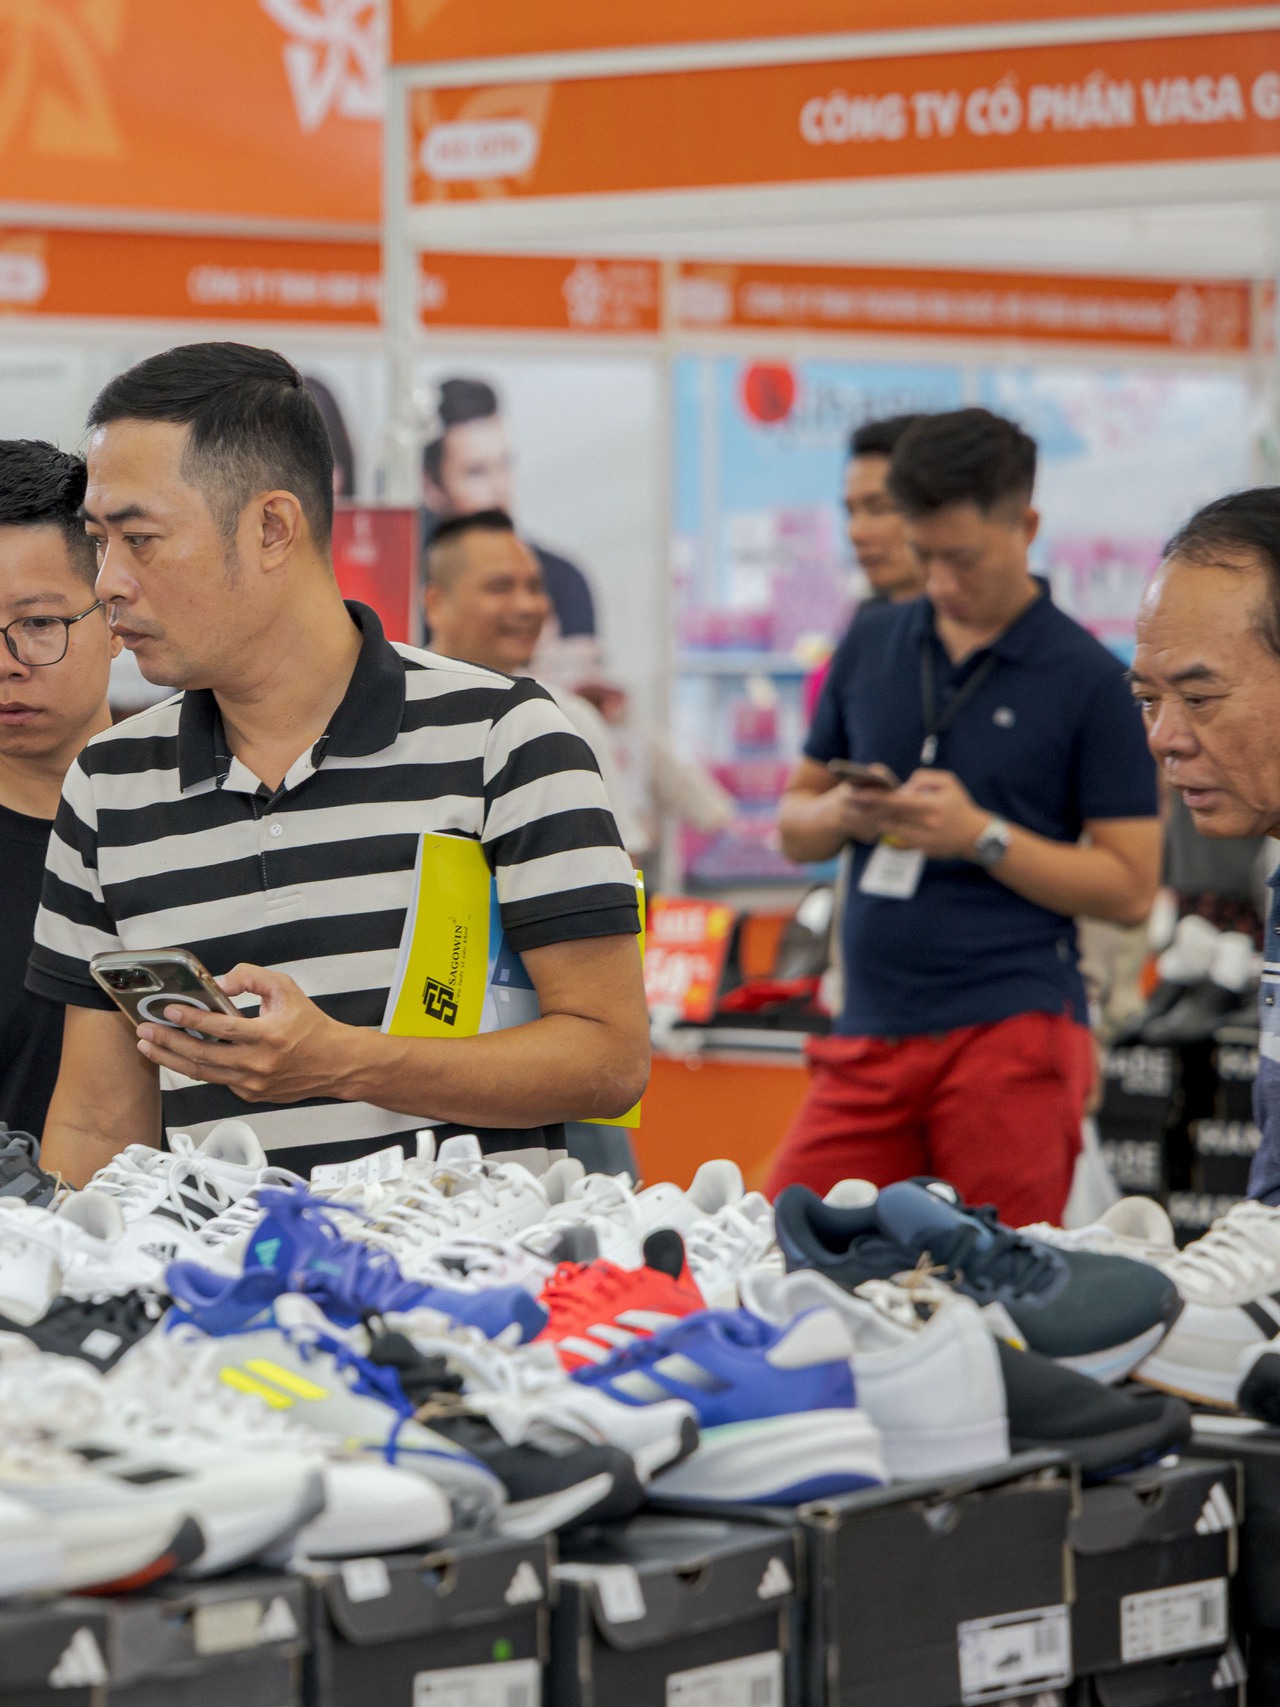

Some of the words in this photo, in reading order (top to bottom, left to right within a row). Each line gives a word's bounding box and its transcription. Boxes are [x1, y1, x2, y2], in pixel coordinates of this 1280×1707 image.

[799, 89, 908, 144] CÔNG
[911, 91, 962, 138] TY
[1142, 73, 1244, 125] VASA
[448, 925, 463, 985] SAGOWIN
